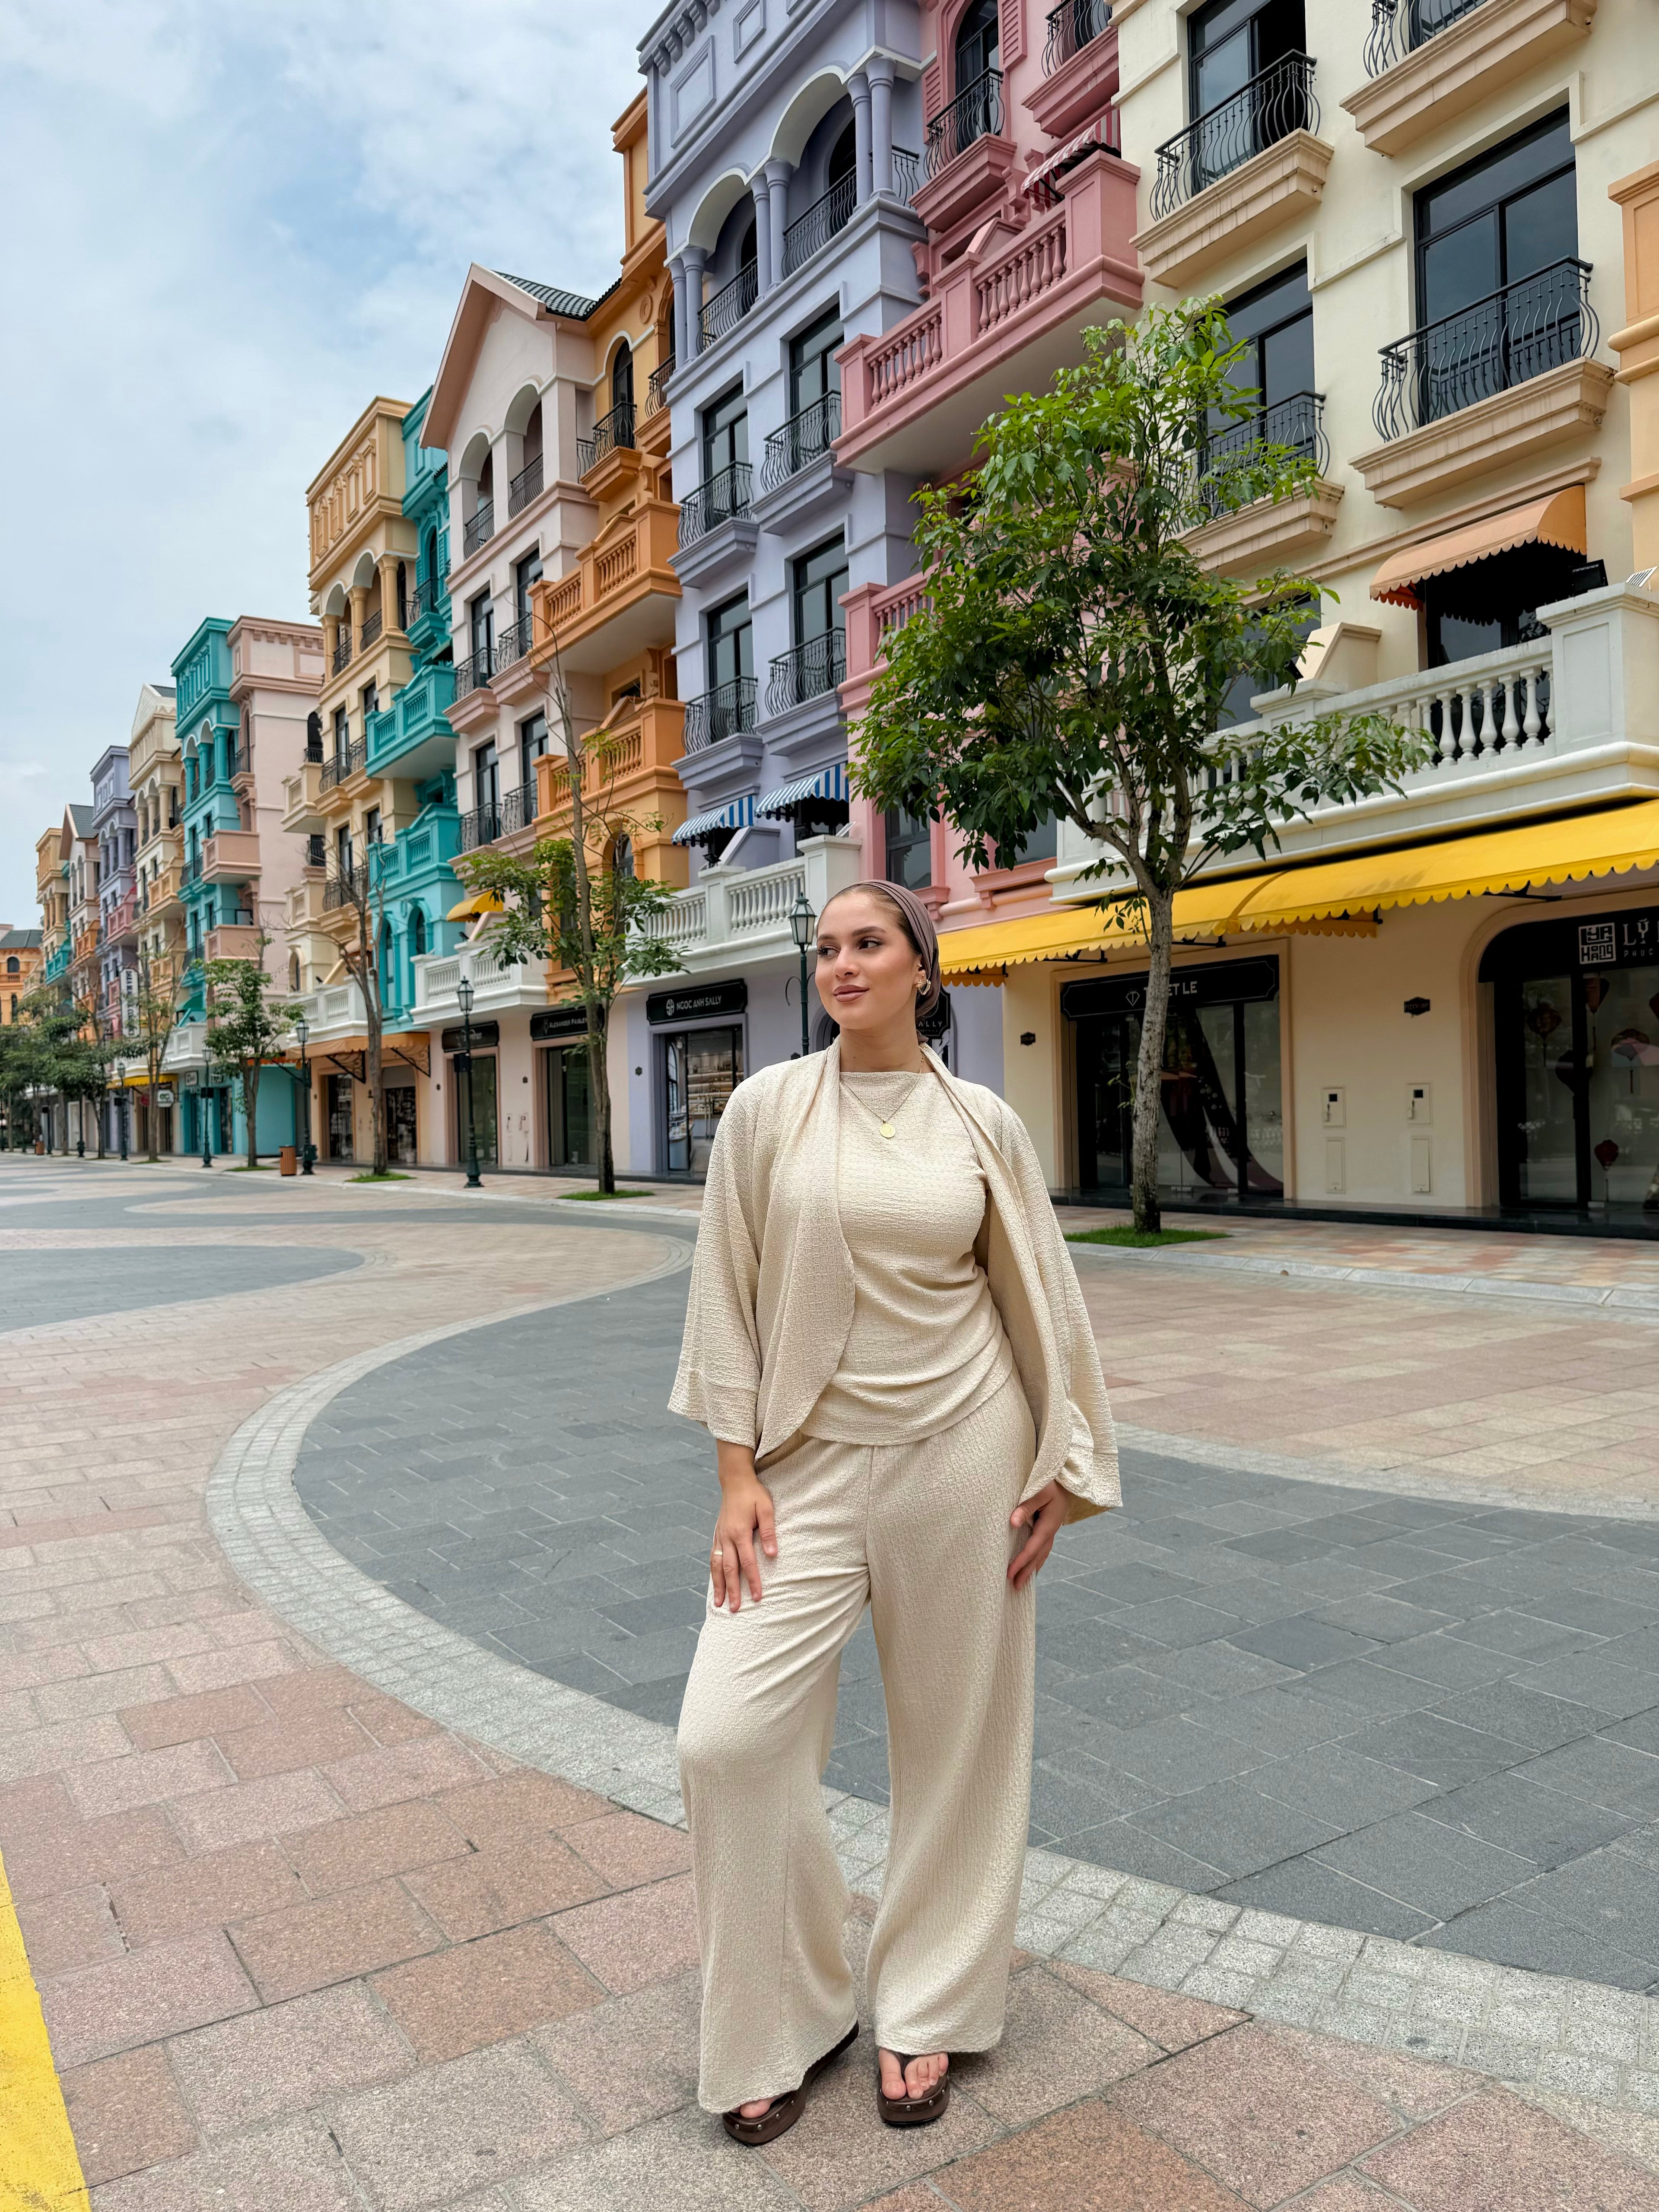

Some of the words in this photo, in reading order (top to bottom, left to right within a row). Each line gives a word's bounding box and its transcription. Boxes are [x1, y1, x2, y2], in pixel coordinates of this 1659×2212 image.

[1183, 981, 1197, 994] LE
[693, 998, 705, 1008] ANH
[705, 995, 721, 1006] SALLY
